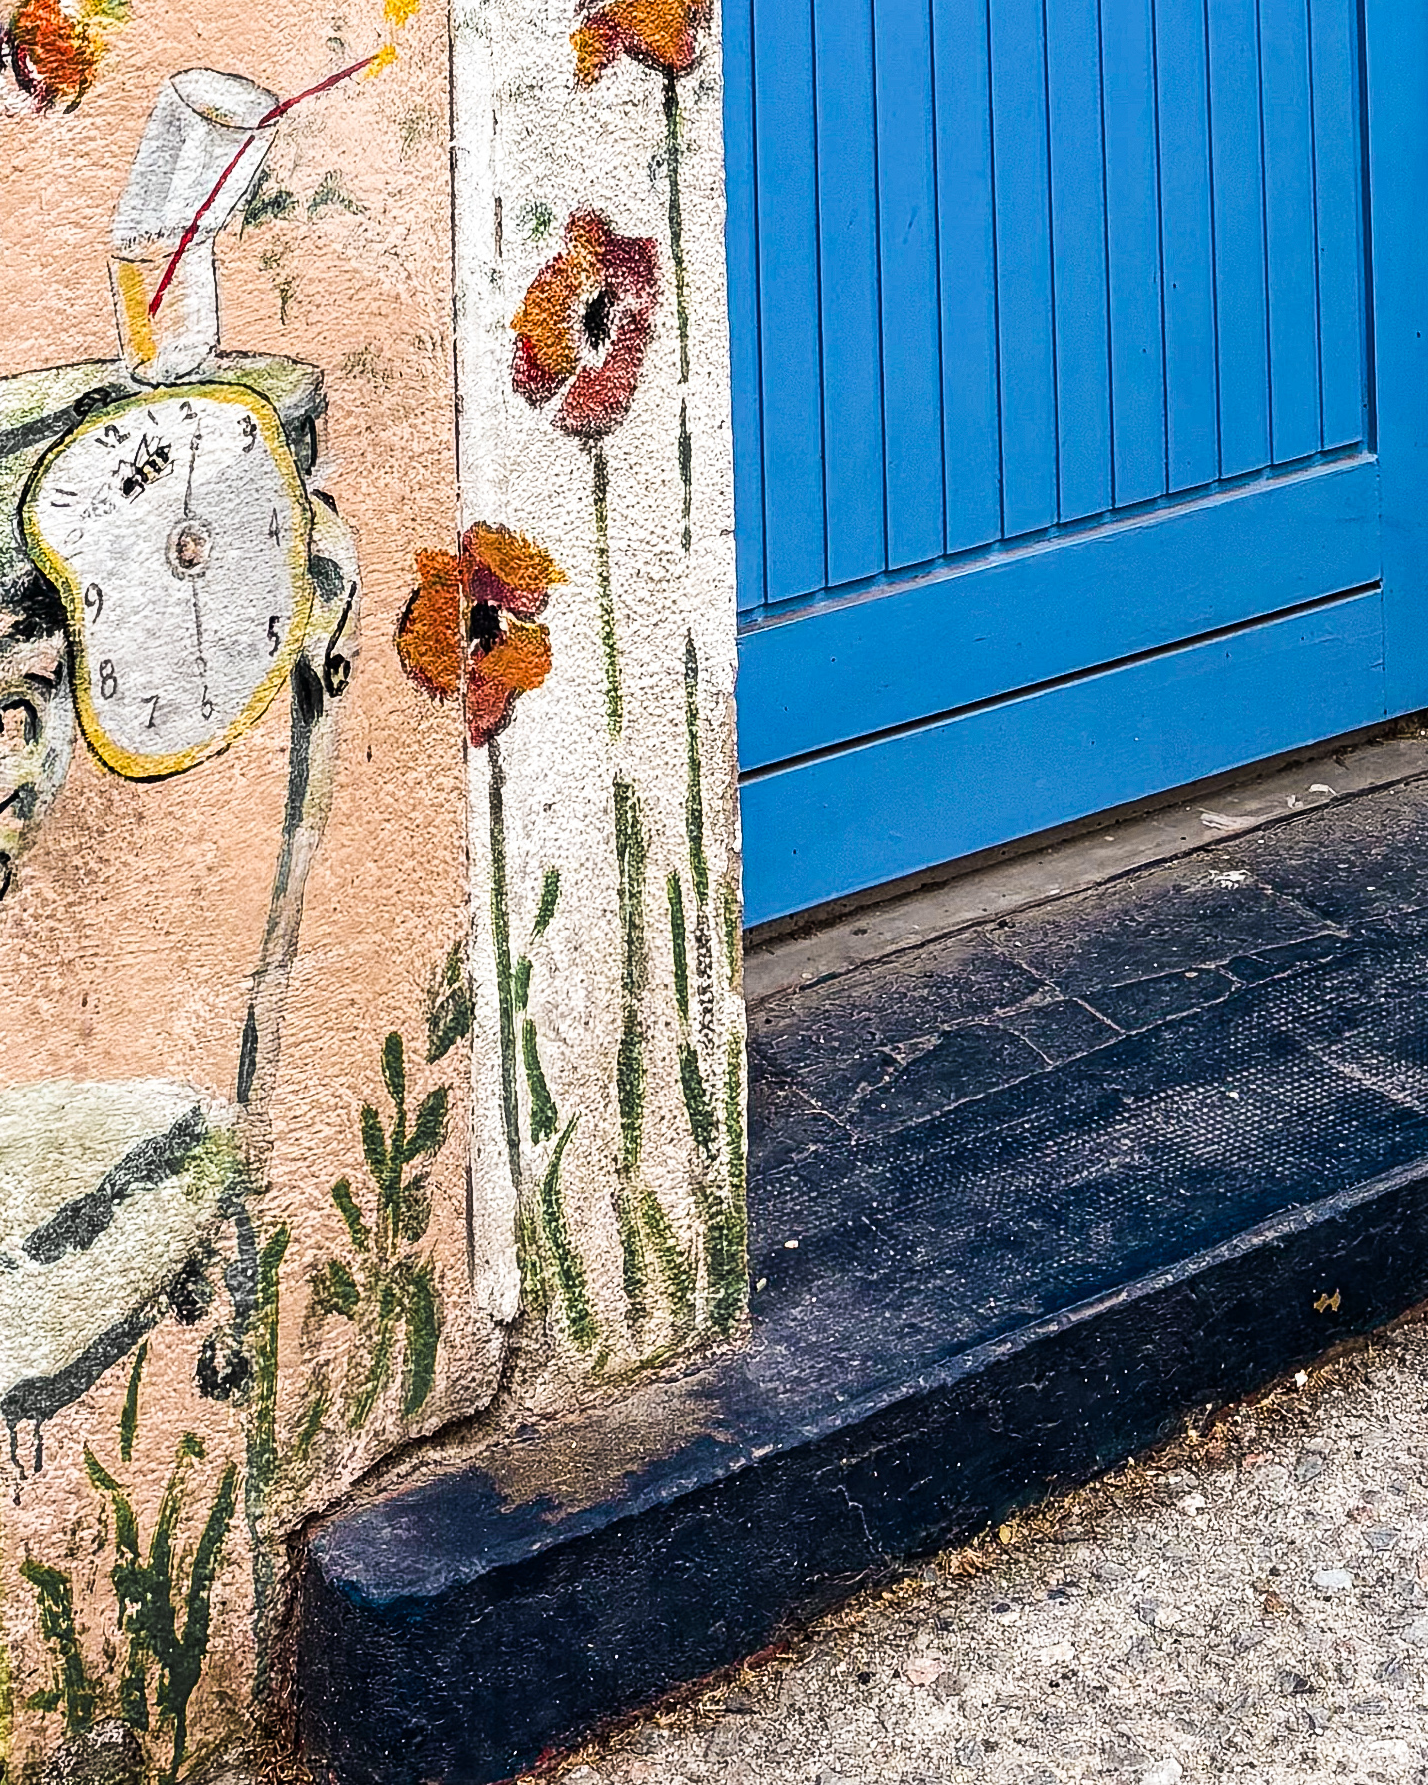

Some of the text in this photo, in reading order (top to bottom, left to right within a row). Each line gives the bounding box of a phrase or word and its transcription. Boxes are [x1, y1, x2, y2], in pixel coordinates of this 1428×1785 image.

[179, 400, 198, 422] 2
[94, 424, 131, 448] 12
[237, 414, 257, 453] 3
[84, 582, 104, 624] 9
[267, 615, 281, 656] 5
[99, 658, 117, 700] 8
[141, 693, 160, 730] 7
[201, 684, 215, 720] 6
